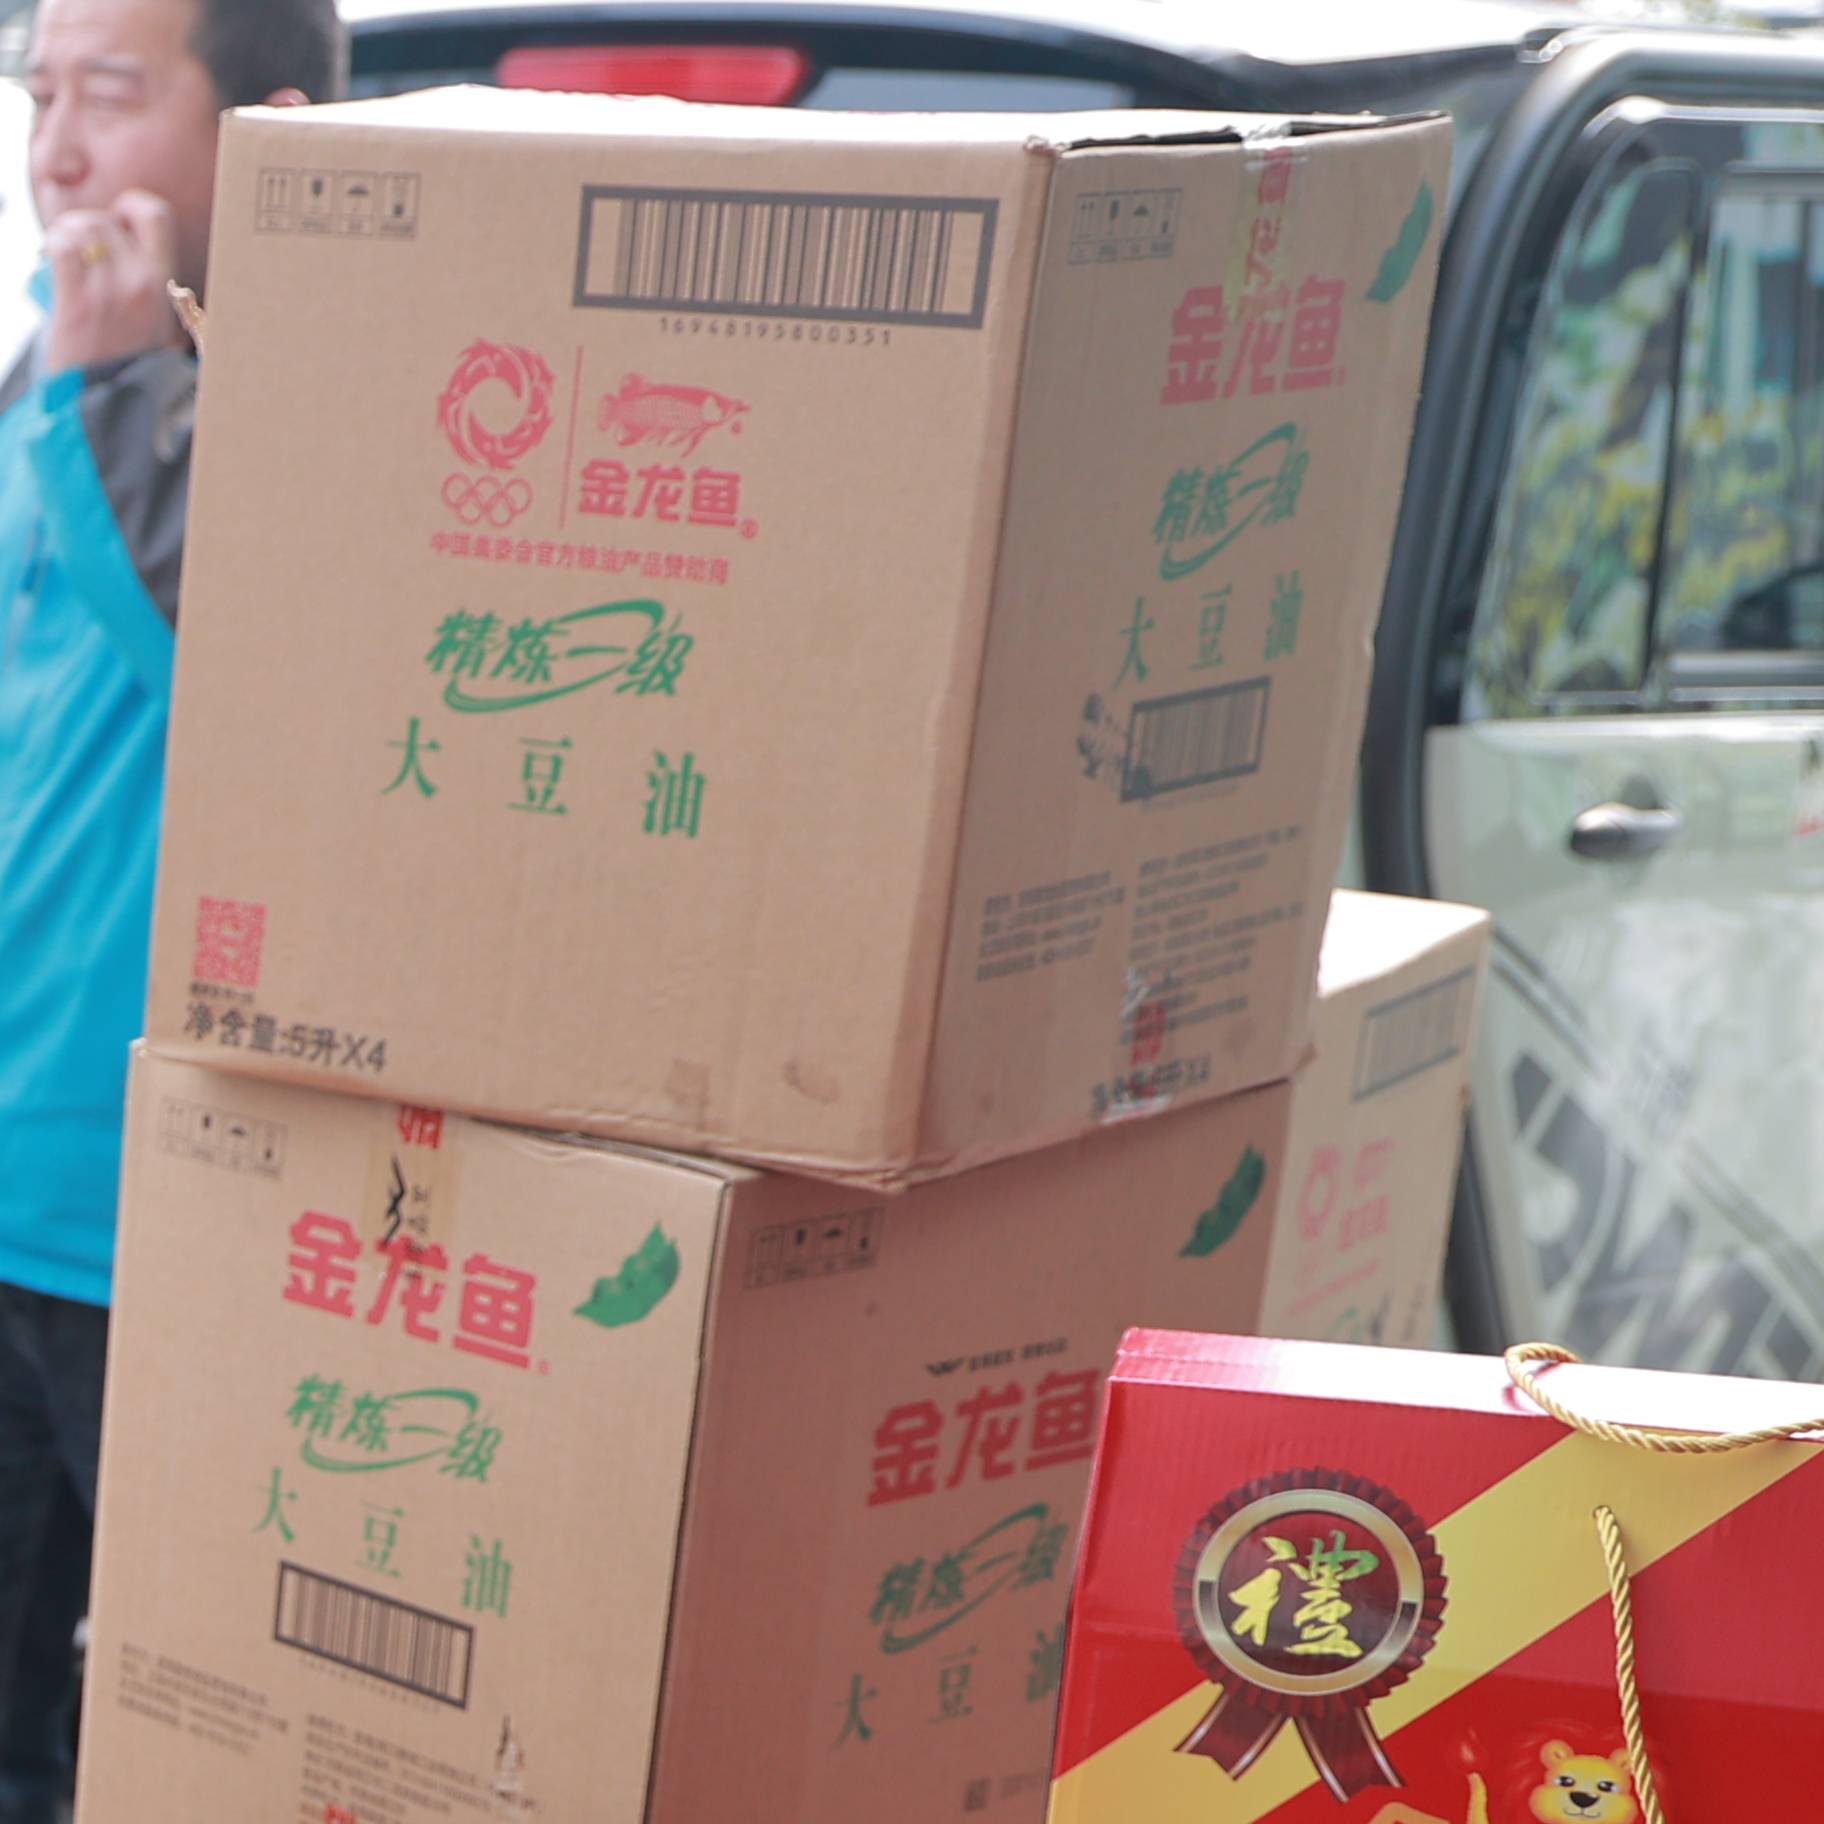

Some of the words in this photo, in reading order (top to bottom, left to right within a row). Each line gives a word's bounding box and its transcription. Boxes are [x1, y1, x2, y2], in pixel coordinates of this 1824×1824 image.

[1160, 275, 1346, 405] 金龙鱼
[577, 456, 742, 529] 金龙鱼
[423, 604, 696, 700] 精炼一级
[382, 716, 707, 839] 大豆油
[282, 1209, 537, 1370] 金龙鱼
[286, 1373, 504, 1483] 精炼一级
[867, 1368, 1101, 1507] 金龙鱼
[253, 1466, 512, 1619] 大豆油
